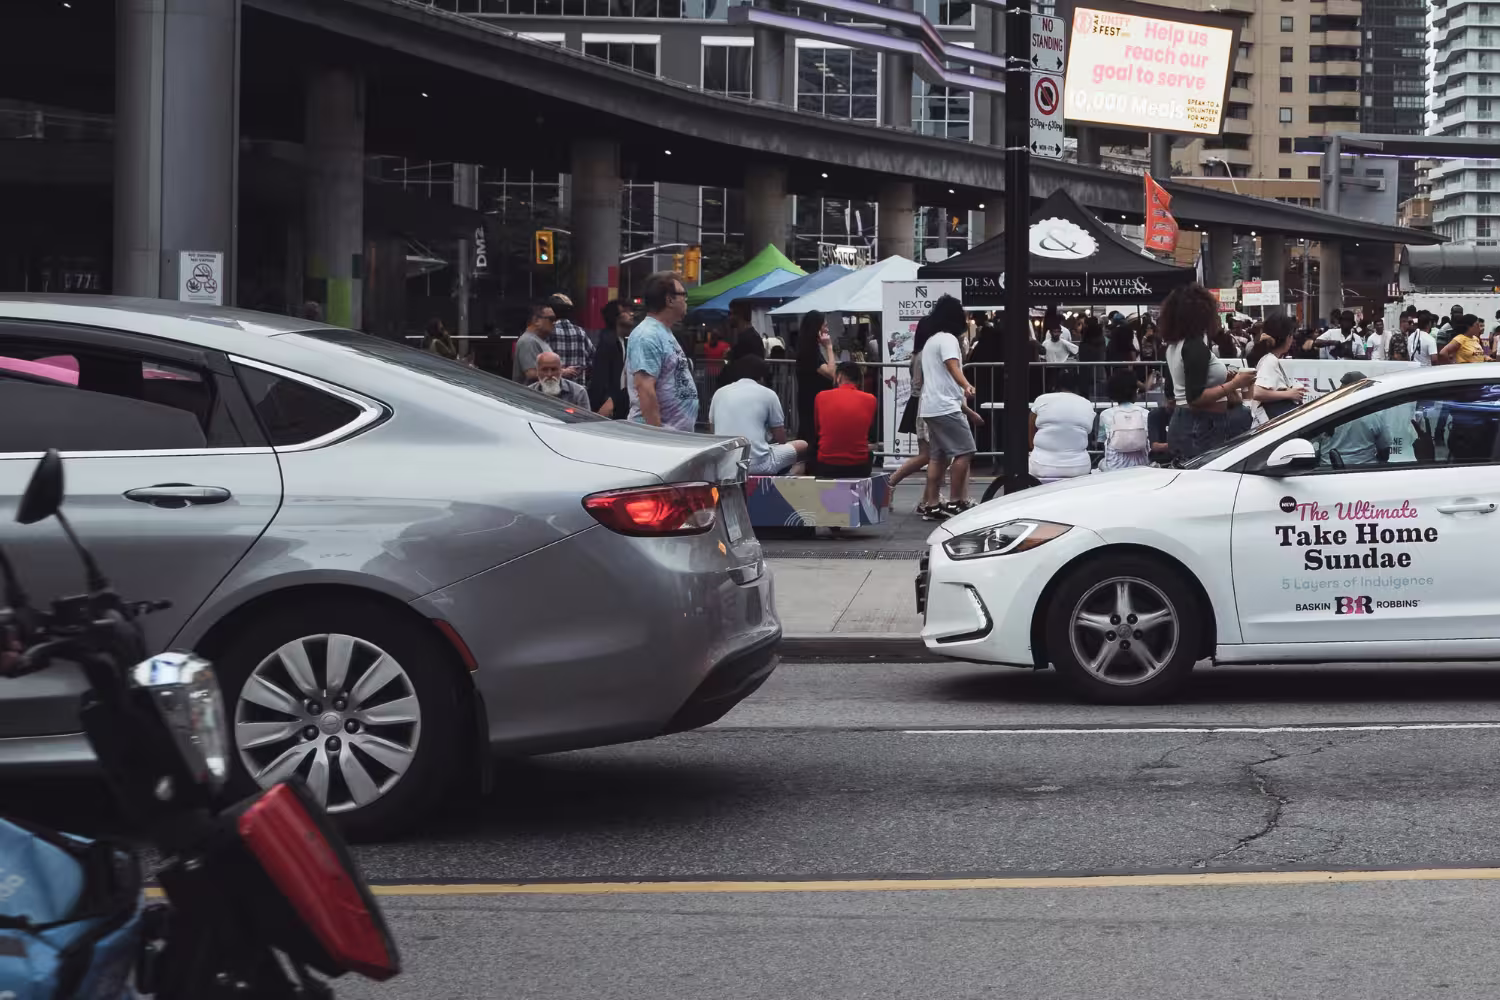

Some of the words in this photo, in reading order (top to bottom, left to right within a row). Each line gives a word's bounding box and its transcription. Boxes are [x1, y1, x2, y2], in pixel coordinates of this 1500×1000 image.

[1042, 17, 1054, 33] NO
[1099, 25, 1121, 37] FEST
[1032, 34, 1063, 52] STANDING
[1144, 22, 1185, 47] Help
[1188, 31, 1208, 46] us
[1124, 44, 1175, 65] reach
[1179, 53, 1209, 68] our
[1092, 64, 1133, 84] goal
[1137, 67, 1154, 84] to
[1157, 75, 1206, 90] serve
[1028, 278, 1082, 288] SSOCIATES
[899, 300, 939, 309] NEXTGE
[1296, 501, 1329, 521] The
[1334, 499, 1418, 521] Ultimate
[1275, 524, 1347, 547] Take
[1355, 523, 1438, 544] Home
[1304, 547, 1411, 571] Sundae
[1282, 578, 1290, 590] 5
[1294, 578, 1339, 592] Layers
[1343, 576, 1357, 588] of
[1360, 575, 1434, 591] Indulgence
[1295, 602, 1331, 611] BASKIN
[1376, 599, 1420, 609] ROBBINS
